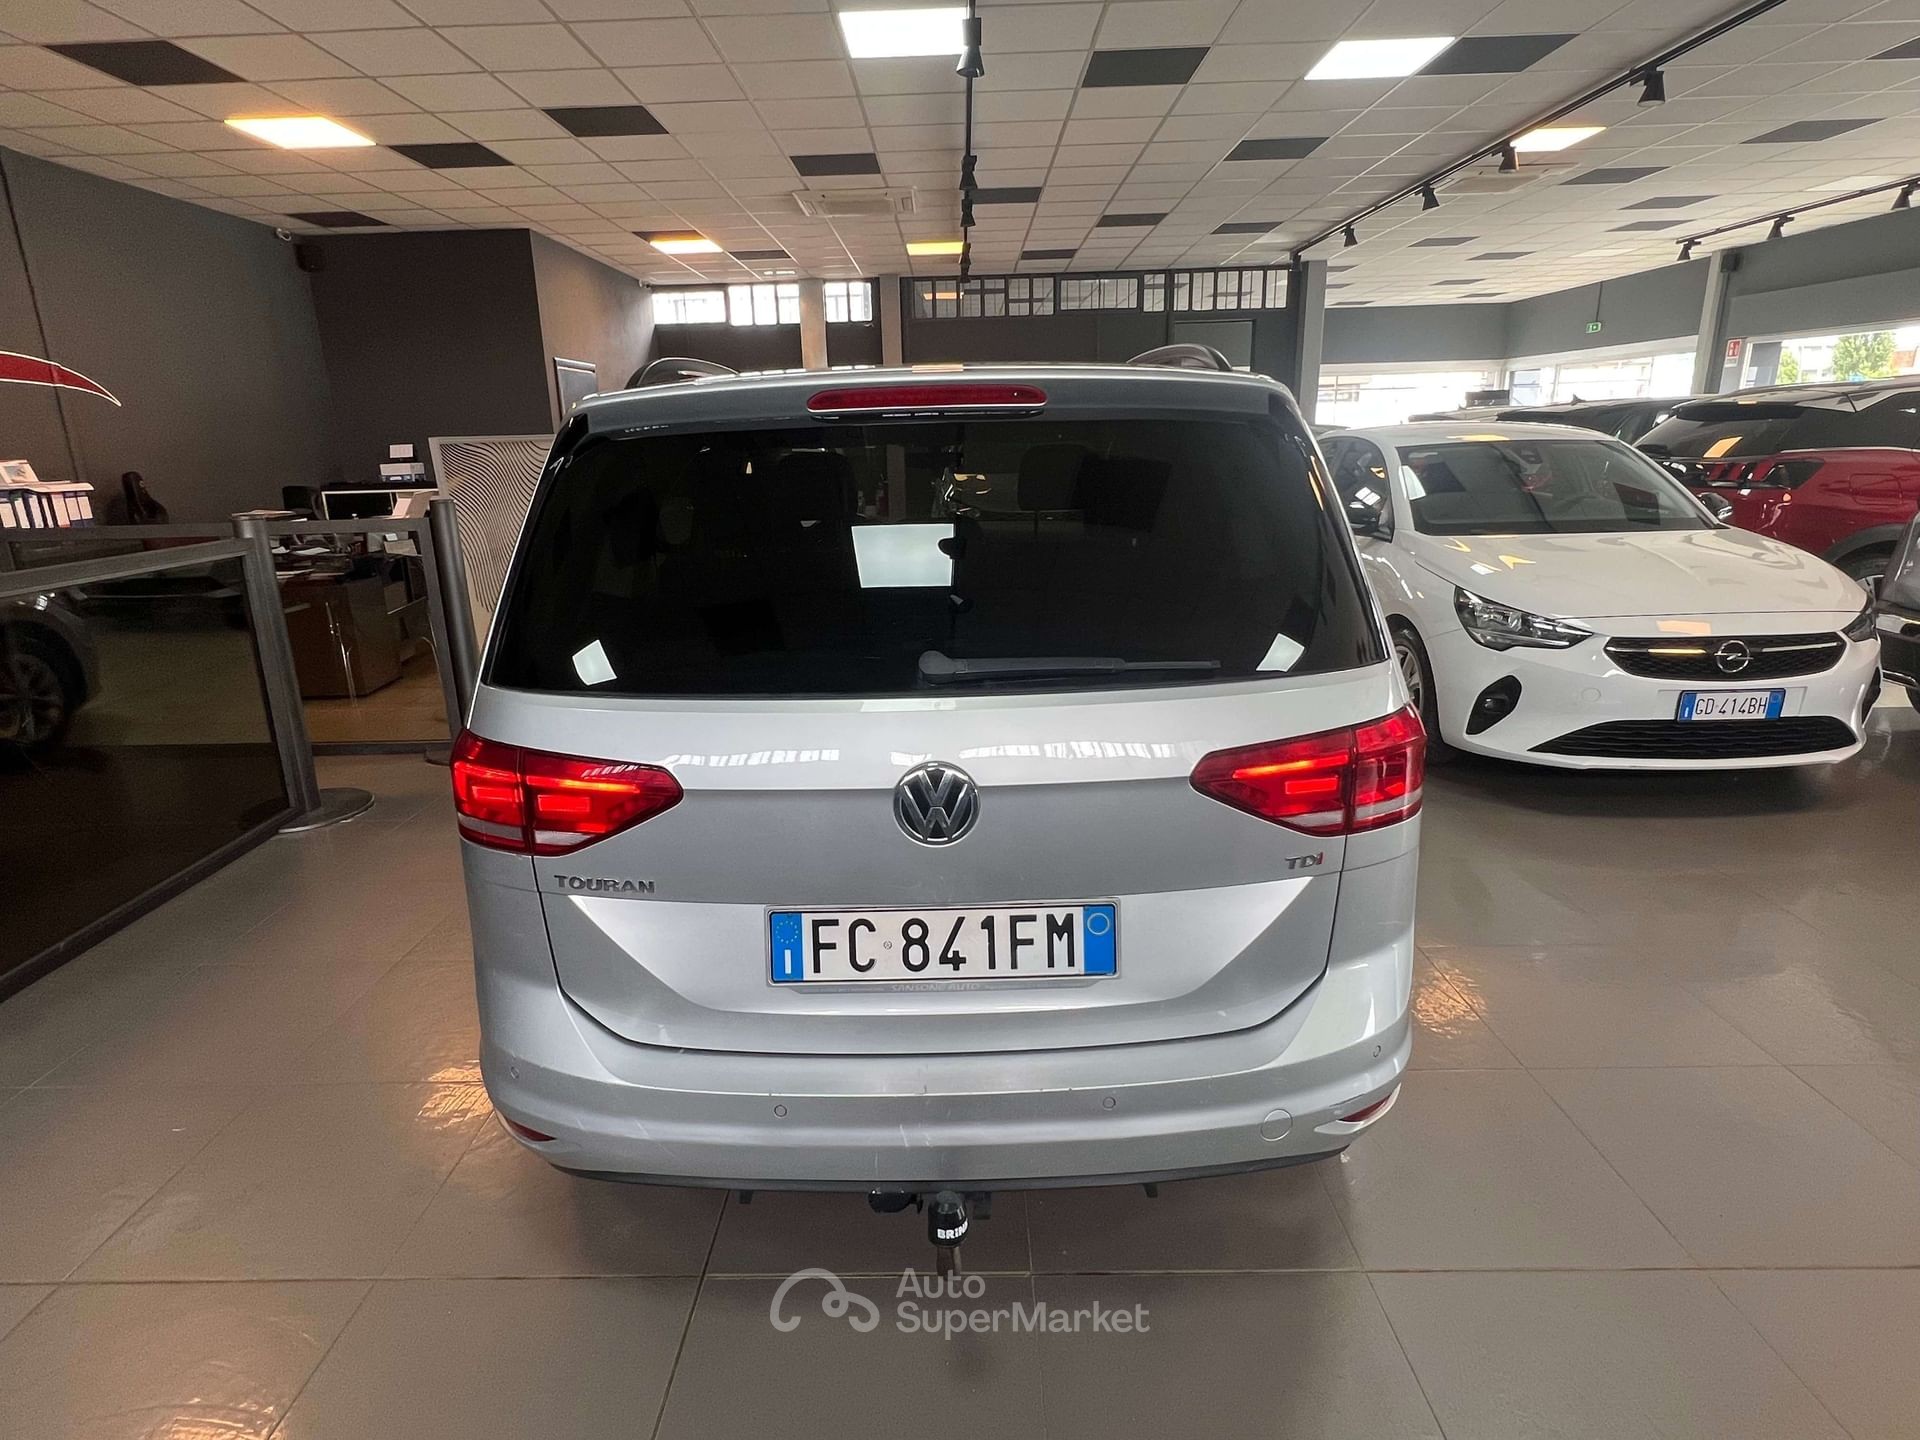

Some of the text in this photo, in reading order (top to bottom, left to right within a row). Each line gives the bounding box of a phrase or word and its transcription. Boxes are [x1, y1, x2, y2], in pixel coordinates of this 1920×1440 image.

[1695, 696, 1769, 715] GD 414BH
[1284, 851, 1324, 870] TDI
[553, 874, 656, 894] TOURAN
[810, 912, 1076, 974] FC 841FM
[936, 1217, 969, 1240] BRIN
